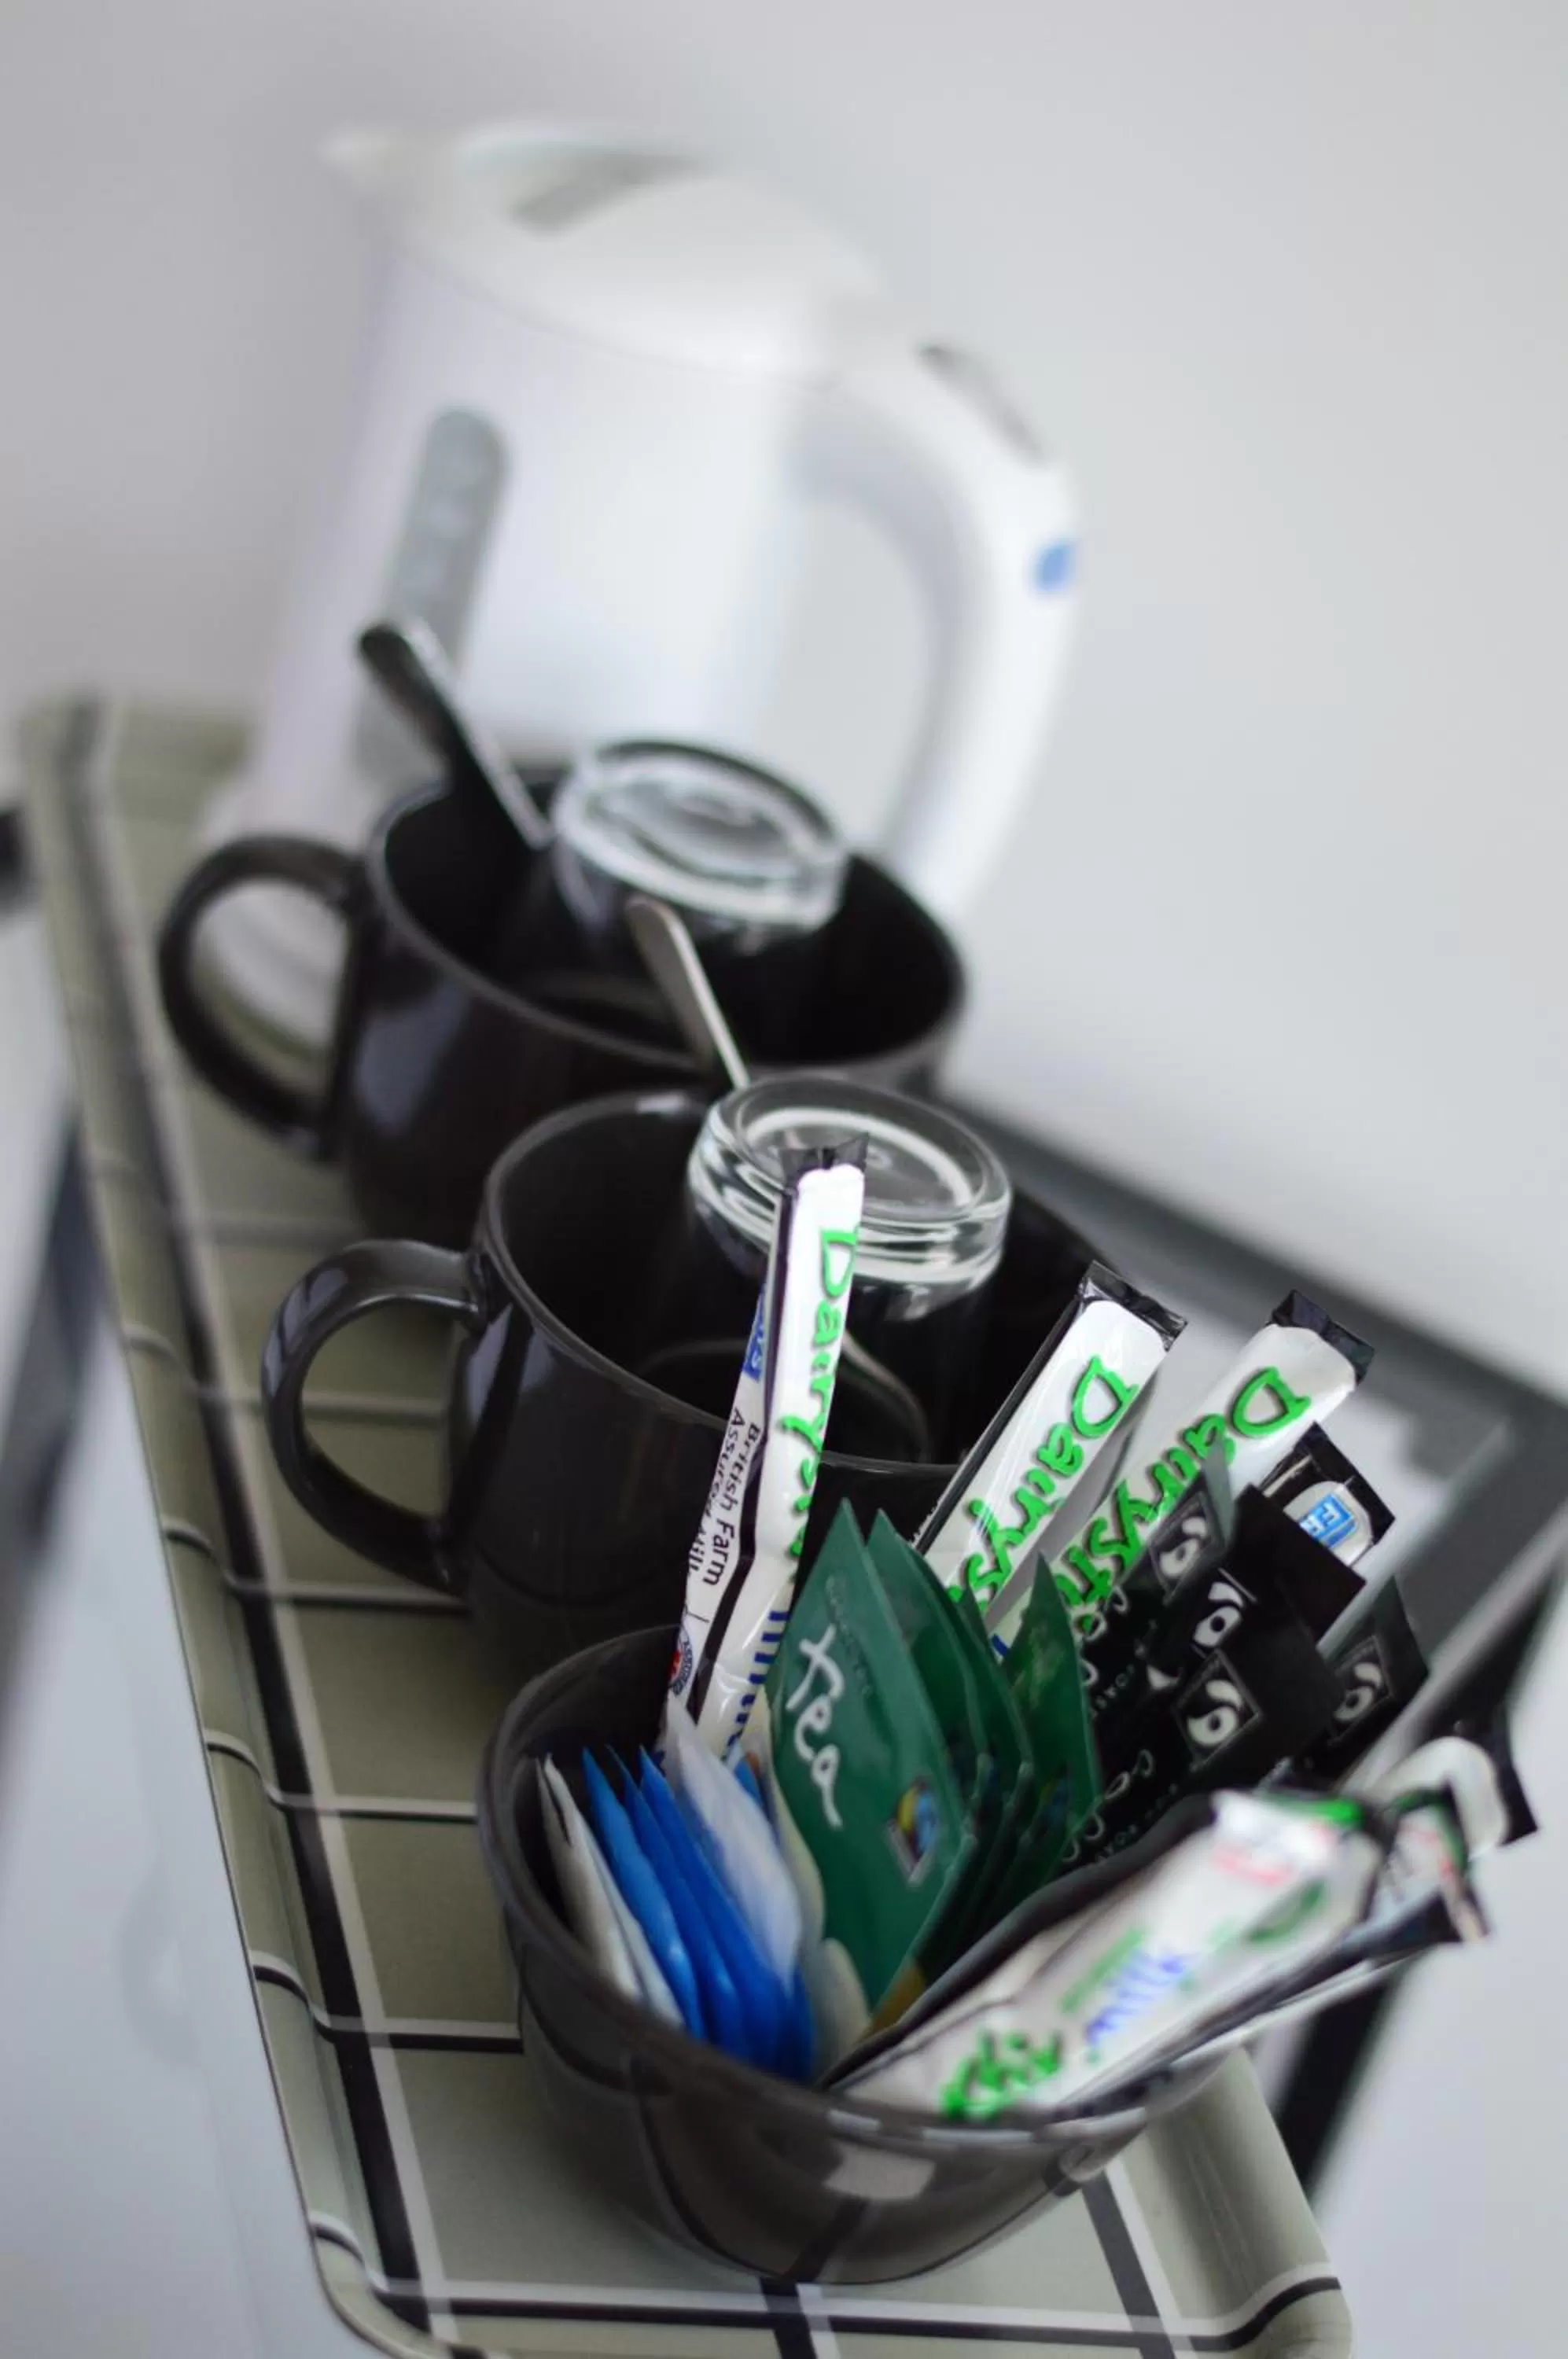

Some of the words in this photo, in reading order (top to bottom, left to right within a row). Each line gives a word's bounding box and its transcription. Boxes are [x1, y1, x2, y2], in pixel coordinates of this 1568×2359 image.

[719, 1421, 760, 1512] British
[702, 1518, 735, 1586] Farm
[786, 1622, 844, 1828] tea
